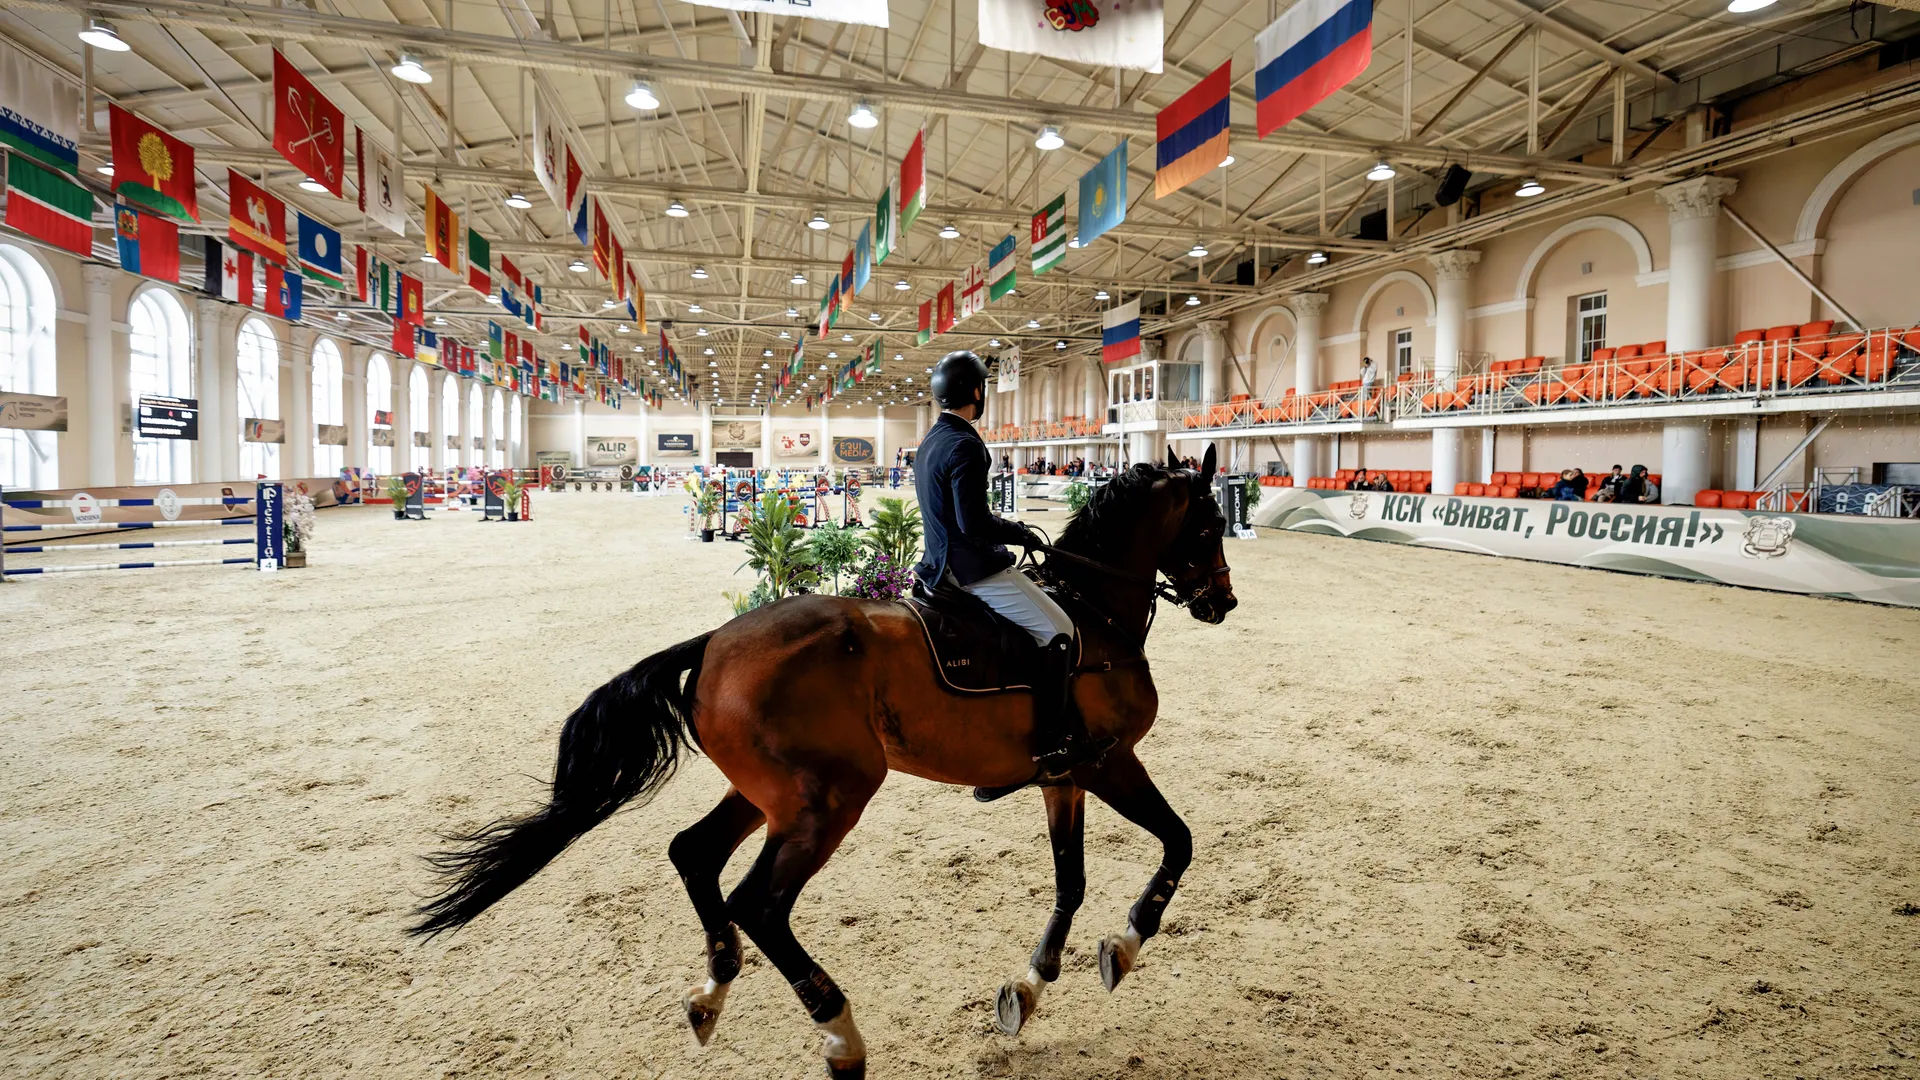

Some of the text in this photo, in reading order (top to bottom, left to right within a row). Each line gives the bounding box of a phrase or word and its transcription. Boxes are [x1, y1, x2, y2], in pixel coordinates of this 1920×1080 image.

[597, 442, 627, 452] ALIR
[840, 449, 868, 457] MEDIA
[263, 487, 277, 558] Prestig
[1381, 494, 1724, 548] КСК «Виват, Россия!»
[946, 658, 970, 667] ALIBI
